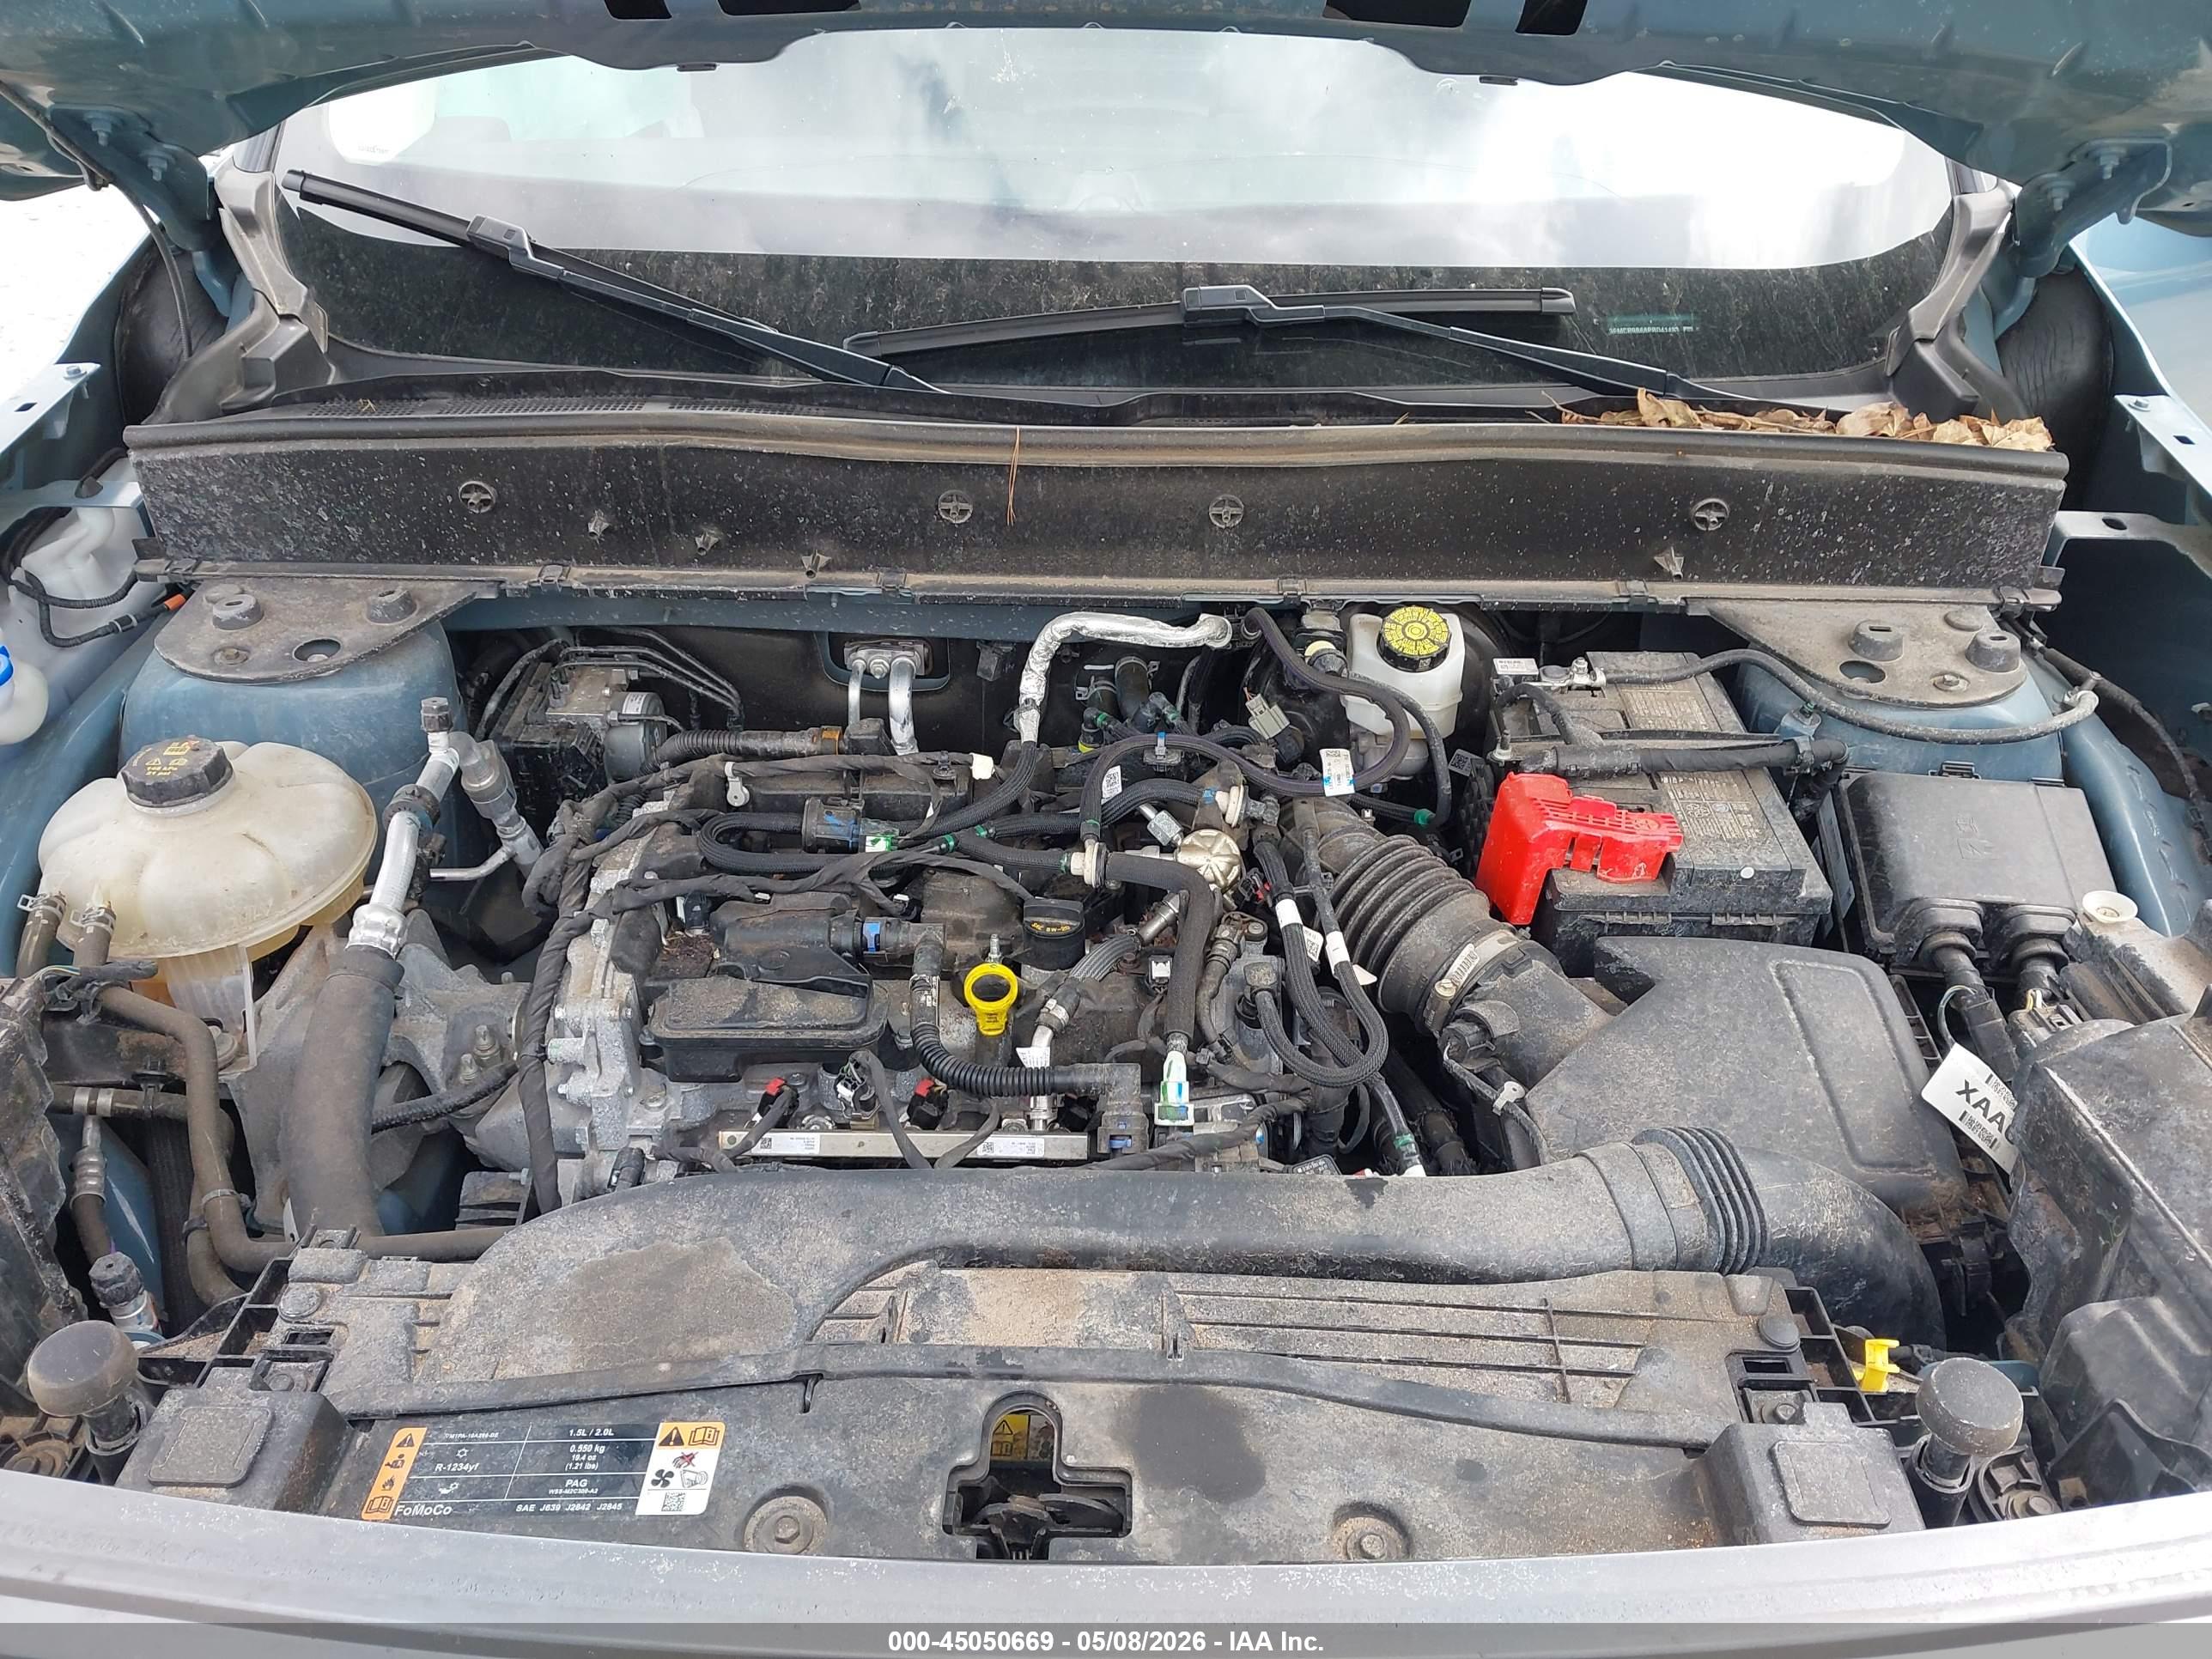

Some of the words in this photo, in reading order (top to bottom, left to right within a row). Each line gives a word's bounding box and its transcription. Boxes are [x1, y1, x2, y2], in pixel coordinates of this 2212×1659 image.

[569, 1444, 593, 1453] 0.550
[594, 1445, 605, 1455] kg
[434, 1462, 480, 1473] R-1234yf
[565, 1479, 588, 1487] PAG
[394, 1504, 453, 1516] FoMoCo
